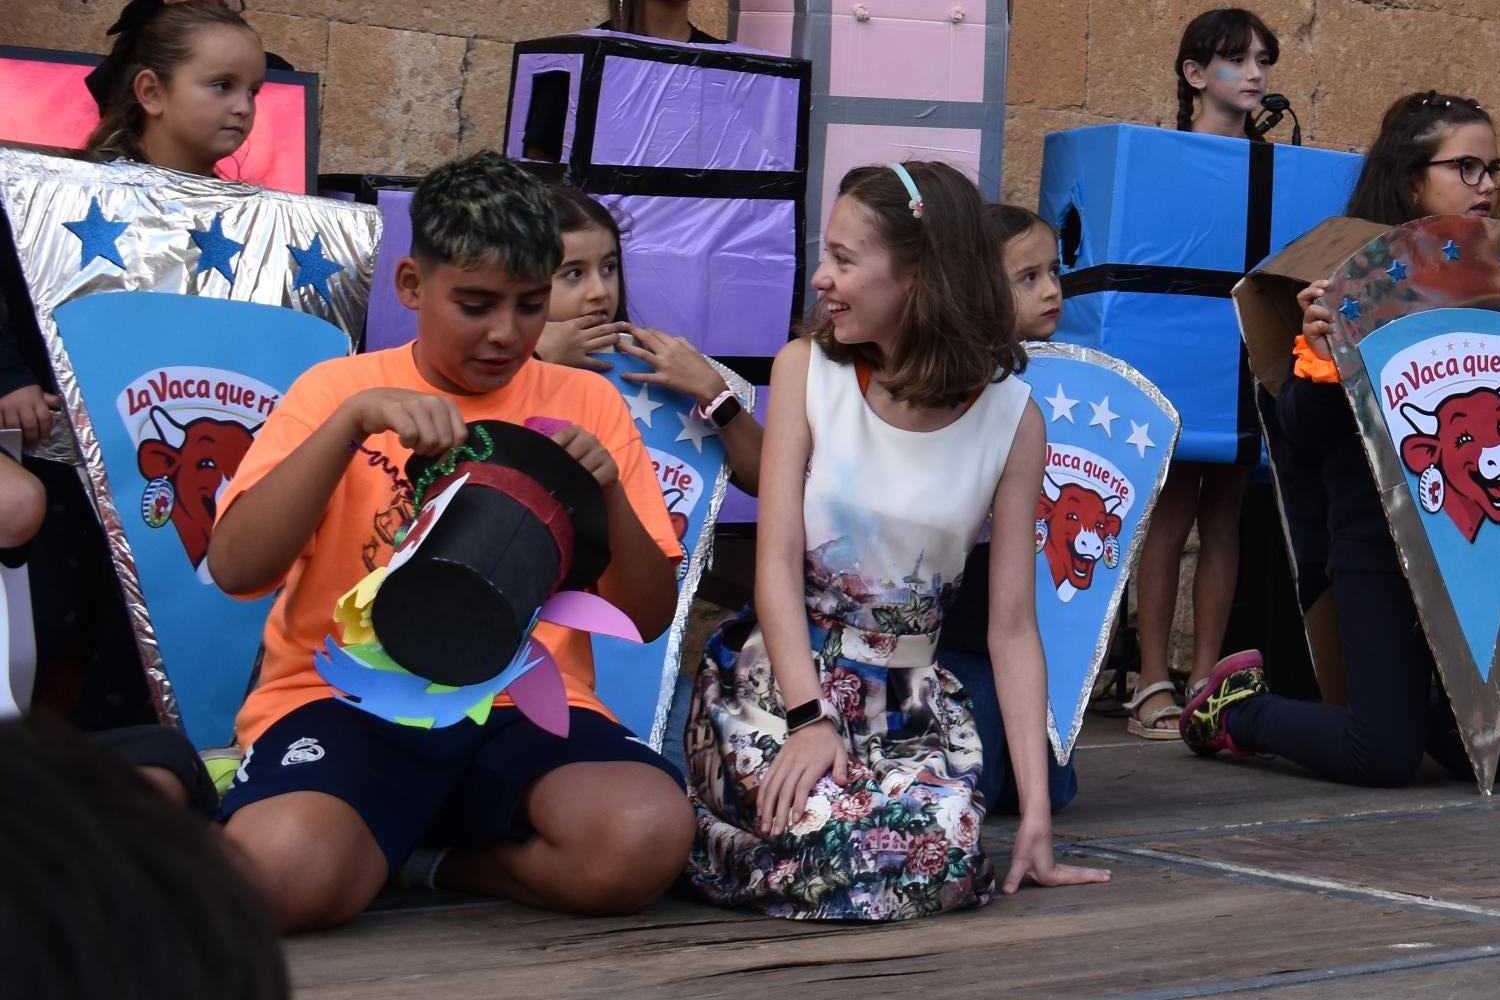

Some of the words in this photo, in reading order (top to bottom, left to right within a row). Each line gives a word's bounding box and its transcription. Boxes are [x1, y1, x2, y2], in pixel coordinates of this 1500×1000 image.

[126, 388, 153, 416] La
[147, 371, 211, 403] Vaca
[215, 381, 256, 409] que
[1384, 381, 1409, 411] La
[1401, 357, 1460, 391] Vaca
[662, 464, 692, 491] ríe
[1083, 460, 1110, 484] que
[1110, 477, 1129, 500] ríe
